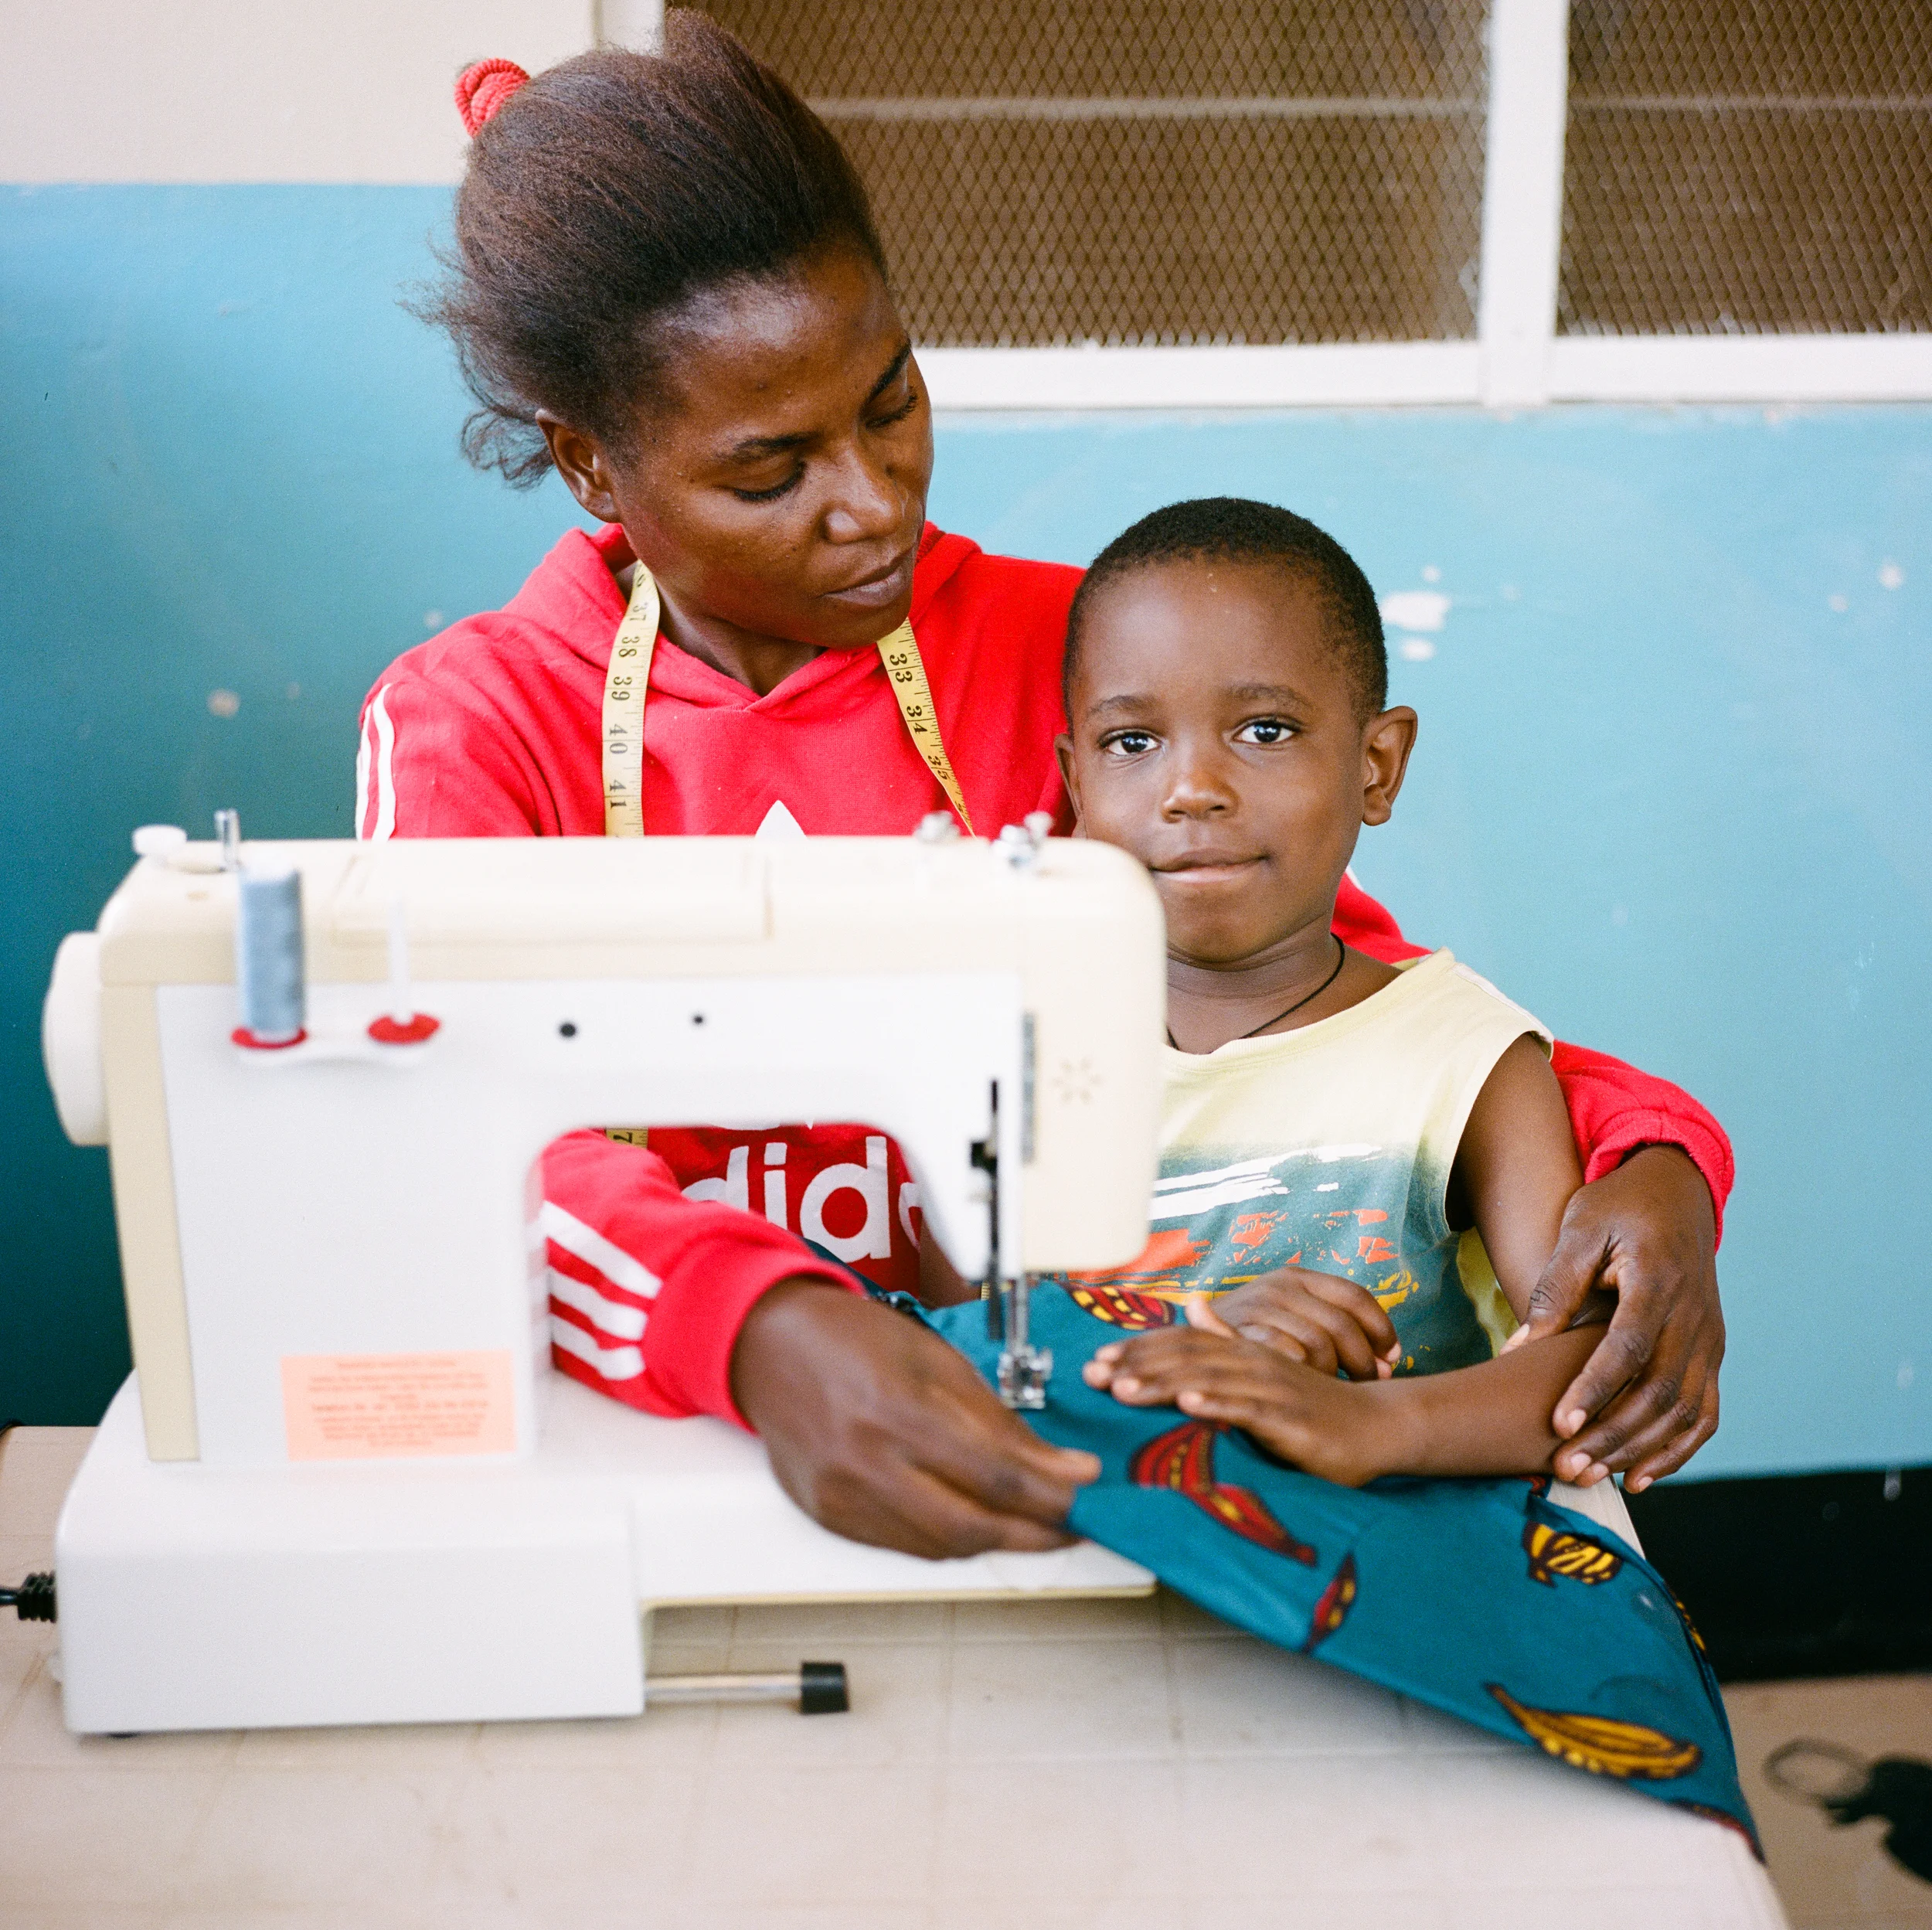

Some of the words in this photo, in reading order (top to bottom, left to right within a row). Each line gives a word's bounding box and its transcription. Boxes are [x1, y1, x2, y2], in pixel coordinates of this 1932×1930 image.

[630, 603, 648, 621] 37
[618, 636, 640, 658] 38
[611, 676, 631, 701] 39
[889, 653, 913, 682] 33
[906, 706, 927, 734] 34
[927, 755, 951, 780] 35
[610, 723, 628, 754] 40
[610, 780, 627, 808] 41
[613, 1132, 633, 1144] 7
